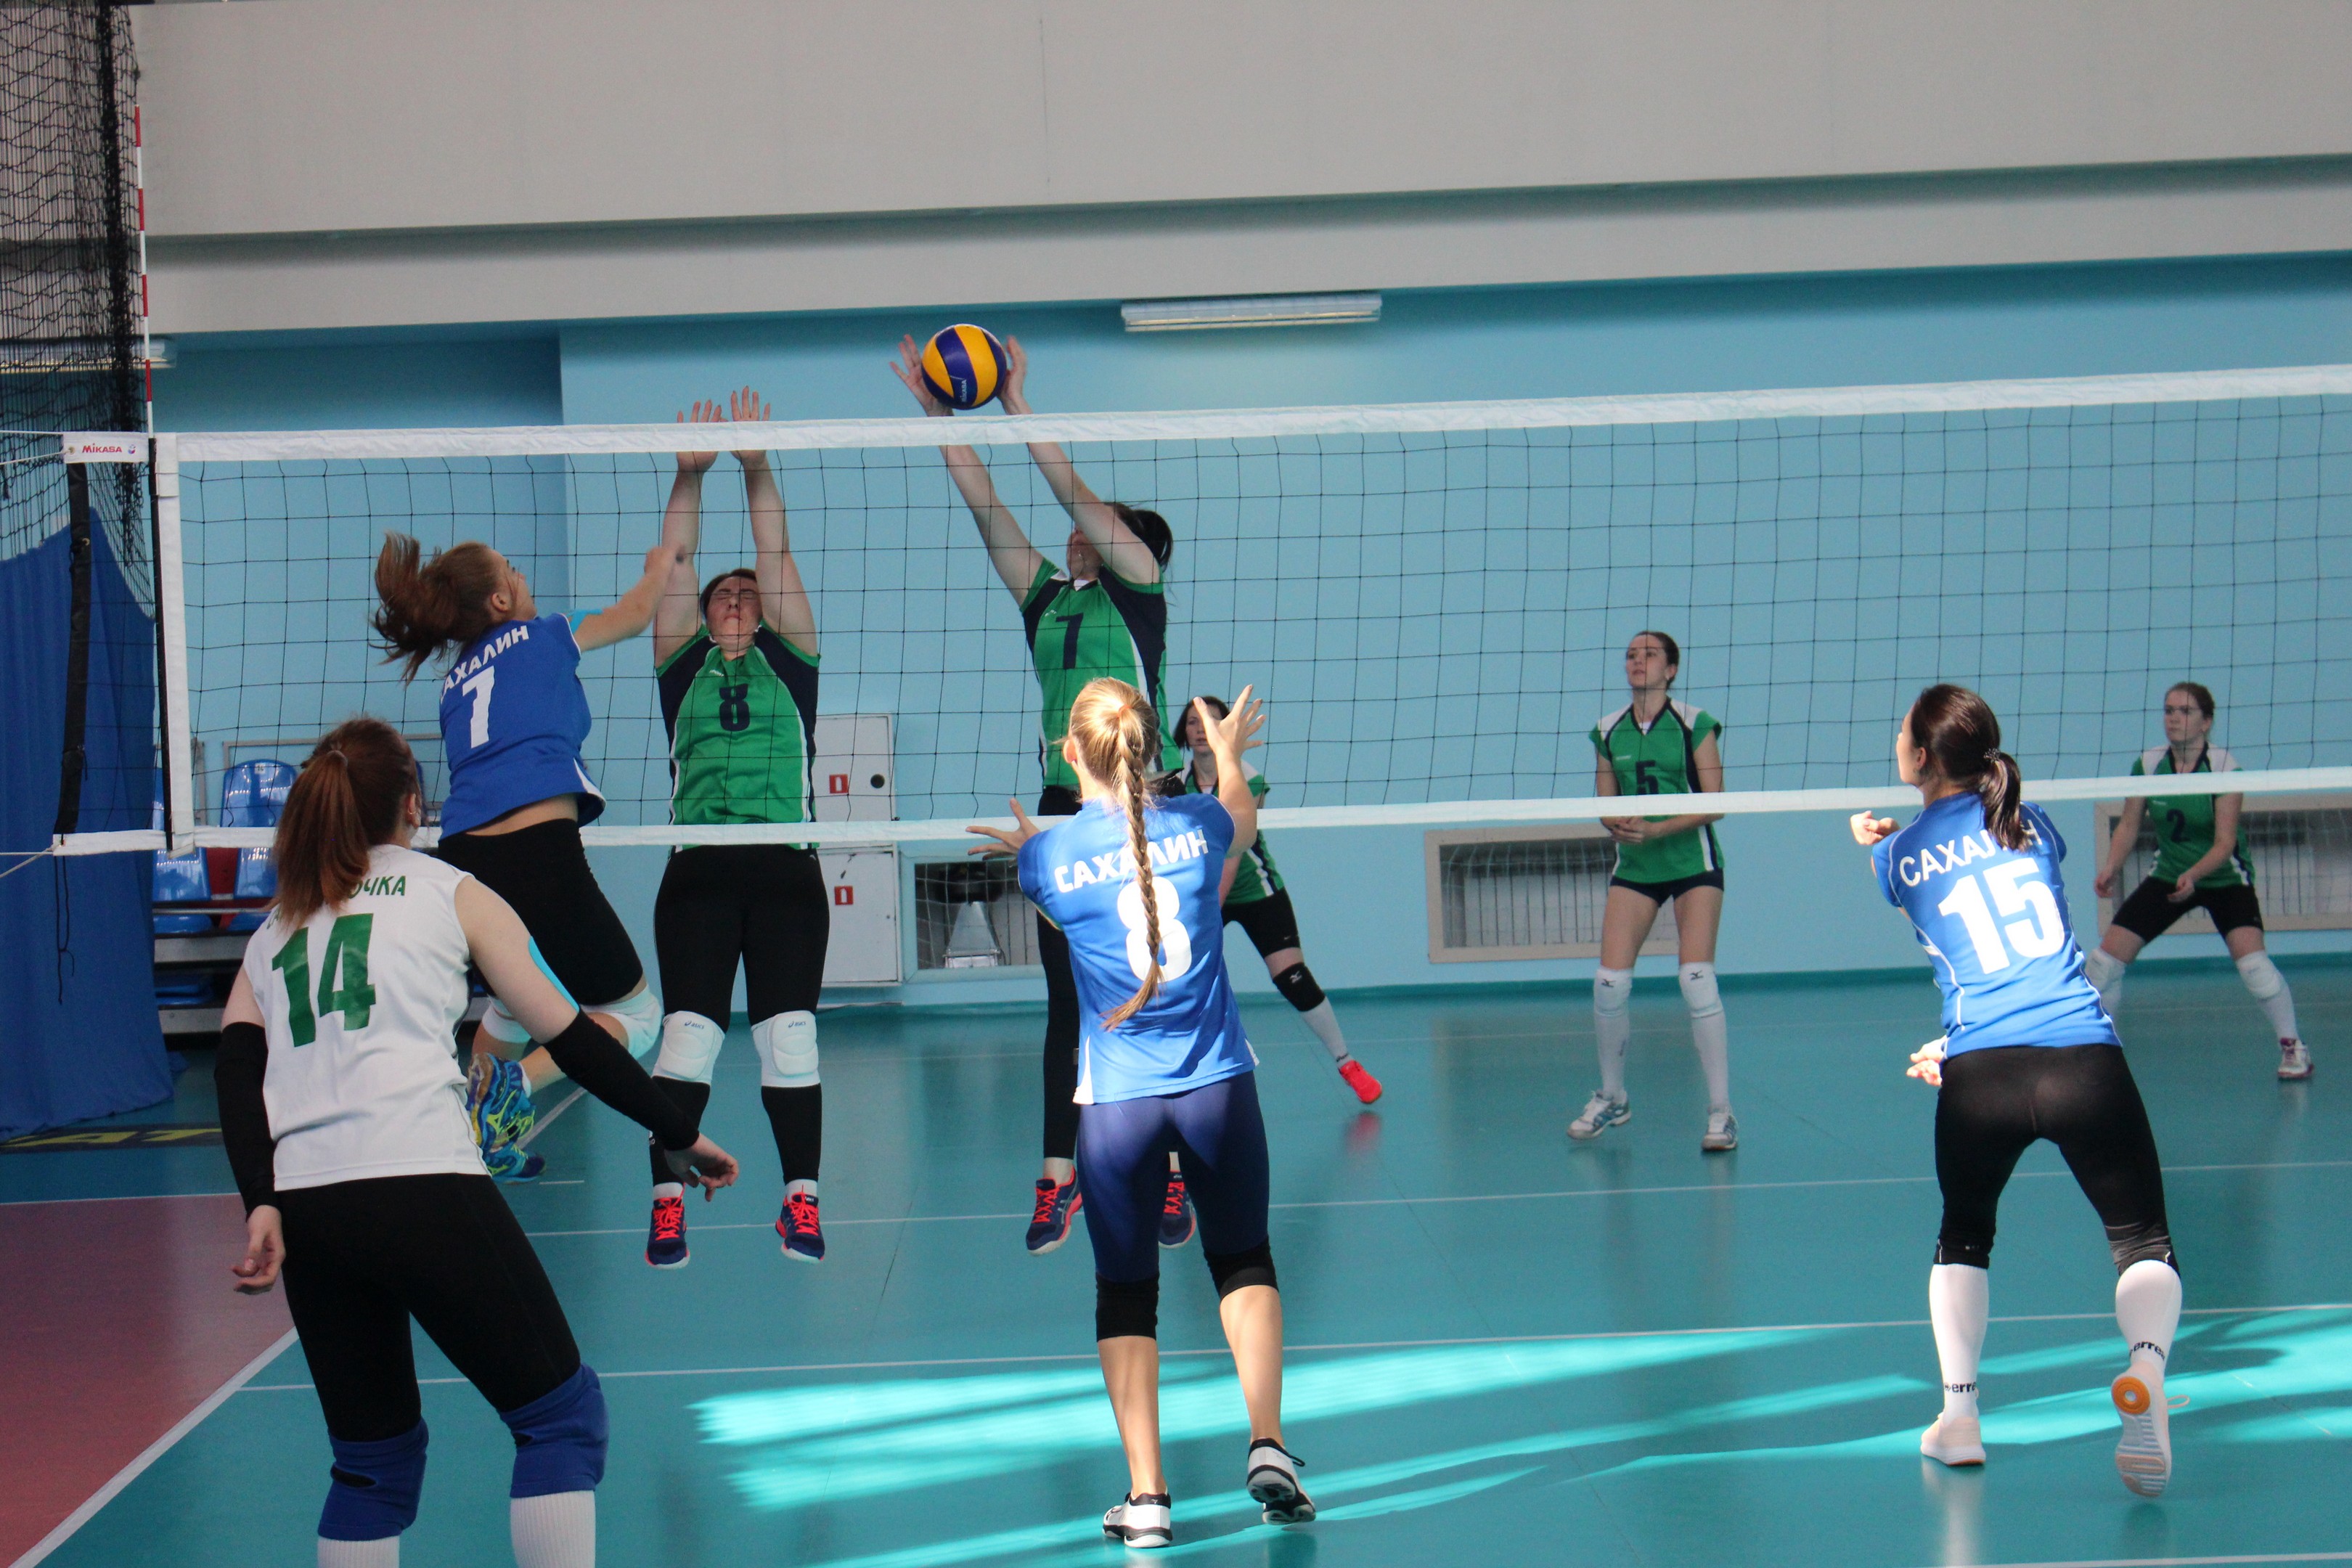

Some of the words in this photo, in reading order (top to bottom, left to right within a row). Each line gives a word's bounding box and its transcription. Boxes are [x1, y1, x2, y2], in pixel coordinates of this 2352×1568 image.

[440, 625, 529, 704] АХАЛИН
[1055, 613, 1084, 670] 7
[462, 666, 495, 749] 7
[719, 684, 751, 732] 8
[1636, 760, 1659, 796] 5
[2166, 808, 2191, 842] 2
[1117, 876, 1193, 984] 8
[1937, 857, 2065, 975] 15
[271, 912, 377, 1048] 14
